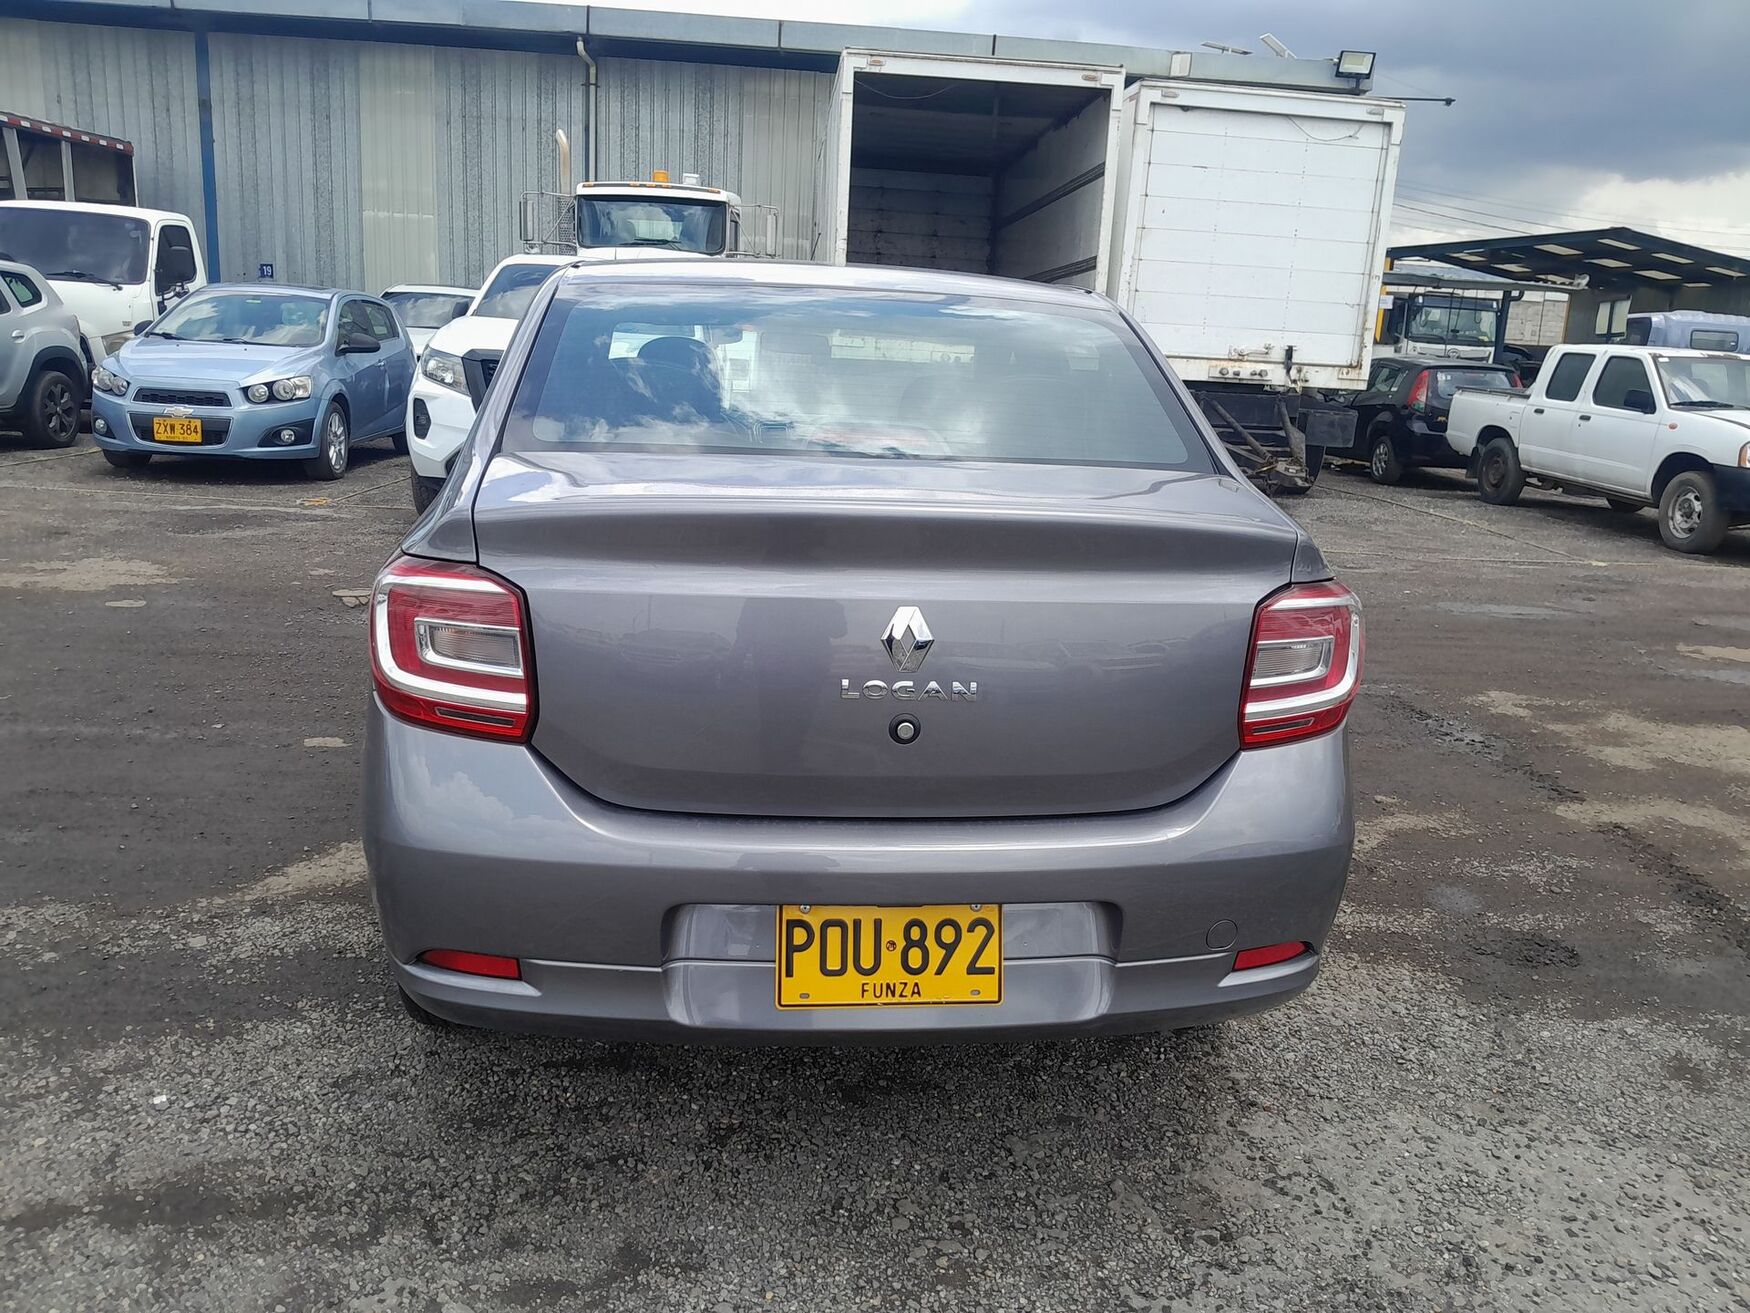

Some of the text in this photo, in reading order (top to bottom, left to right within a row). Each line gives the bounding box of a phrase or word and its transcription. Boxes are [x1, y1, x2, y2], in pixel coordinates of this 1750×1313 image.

[263, 265, 272, 276] 19
[179, 423, 199, 436] 384
[840, 678, 978, 702] LOGAN
[785, 917, 995, 978] POU 892
[861, 982, 922, 999] FUNZA
